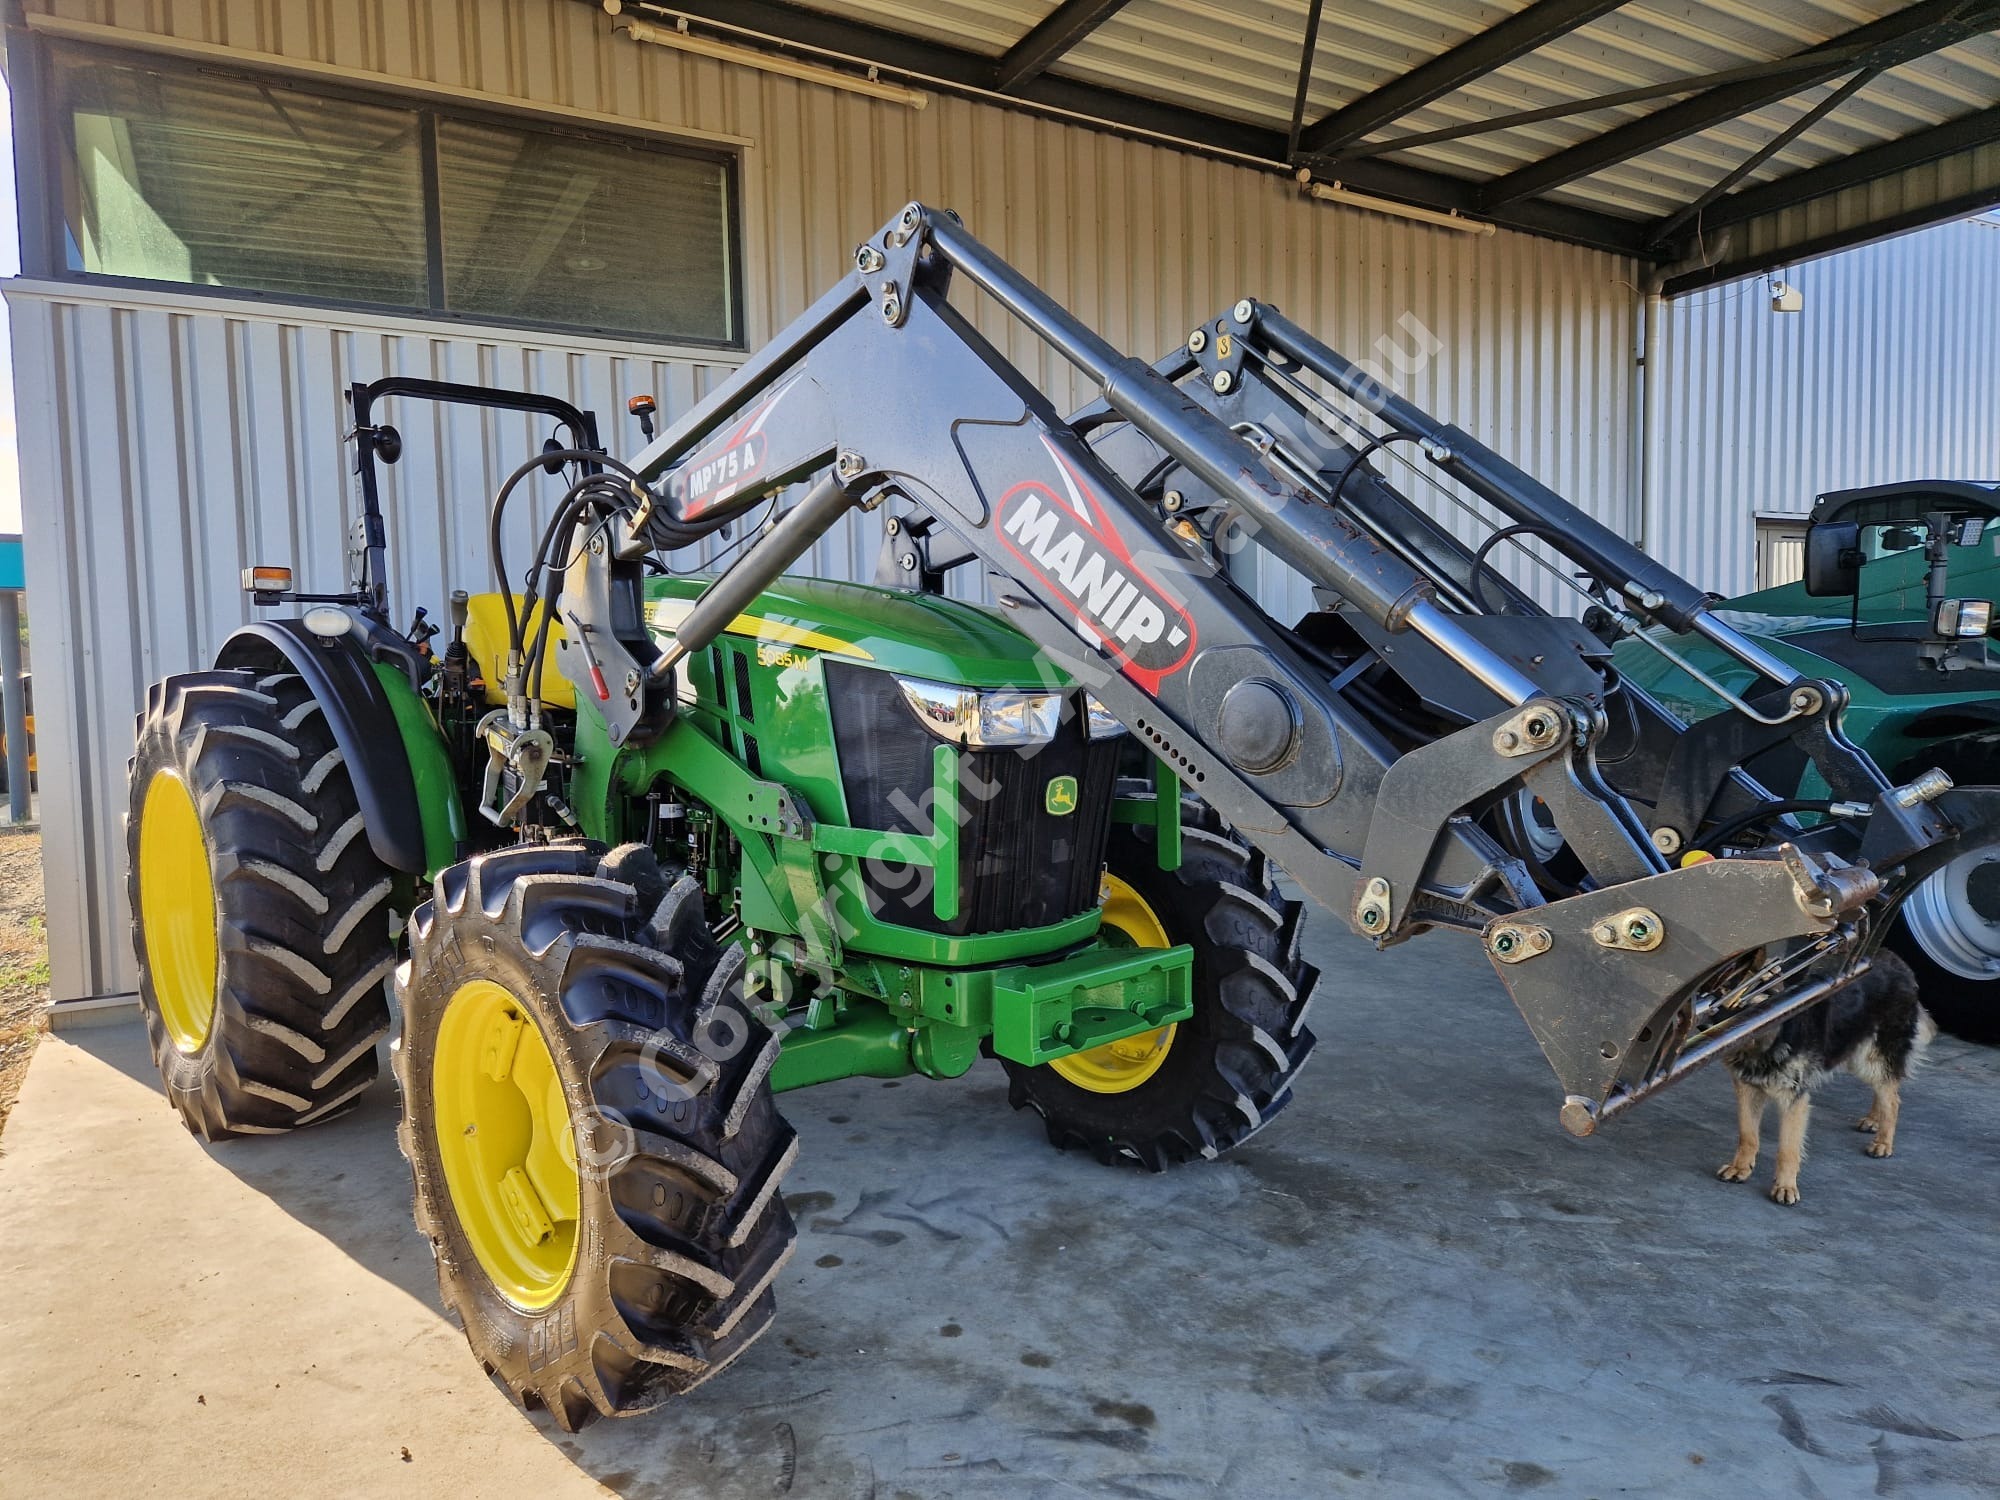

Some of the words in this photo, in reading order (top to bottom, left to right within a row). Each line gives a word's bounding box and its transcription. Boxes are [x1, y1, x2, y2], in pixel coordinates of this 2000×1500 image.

[690, 451, 738, 499] MP'75
[744, 442, 755, 470] A
[1004, 493, 1188, 648] MANIP'
